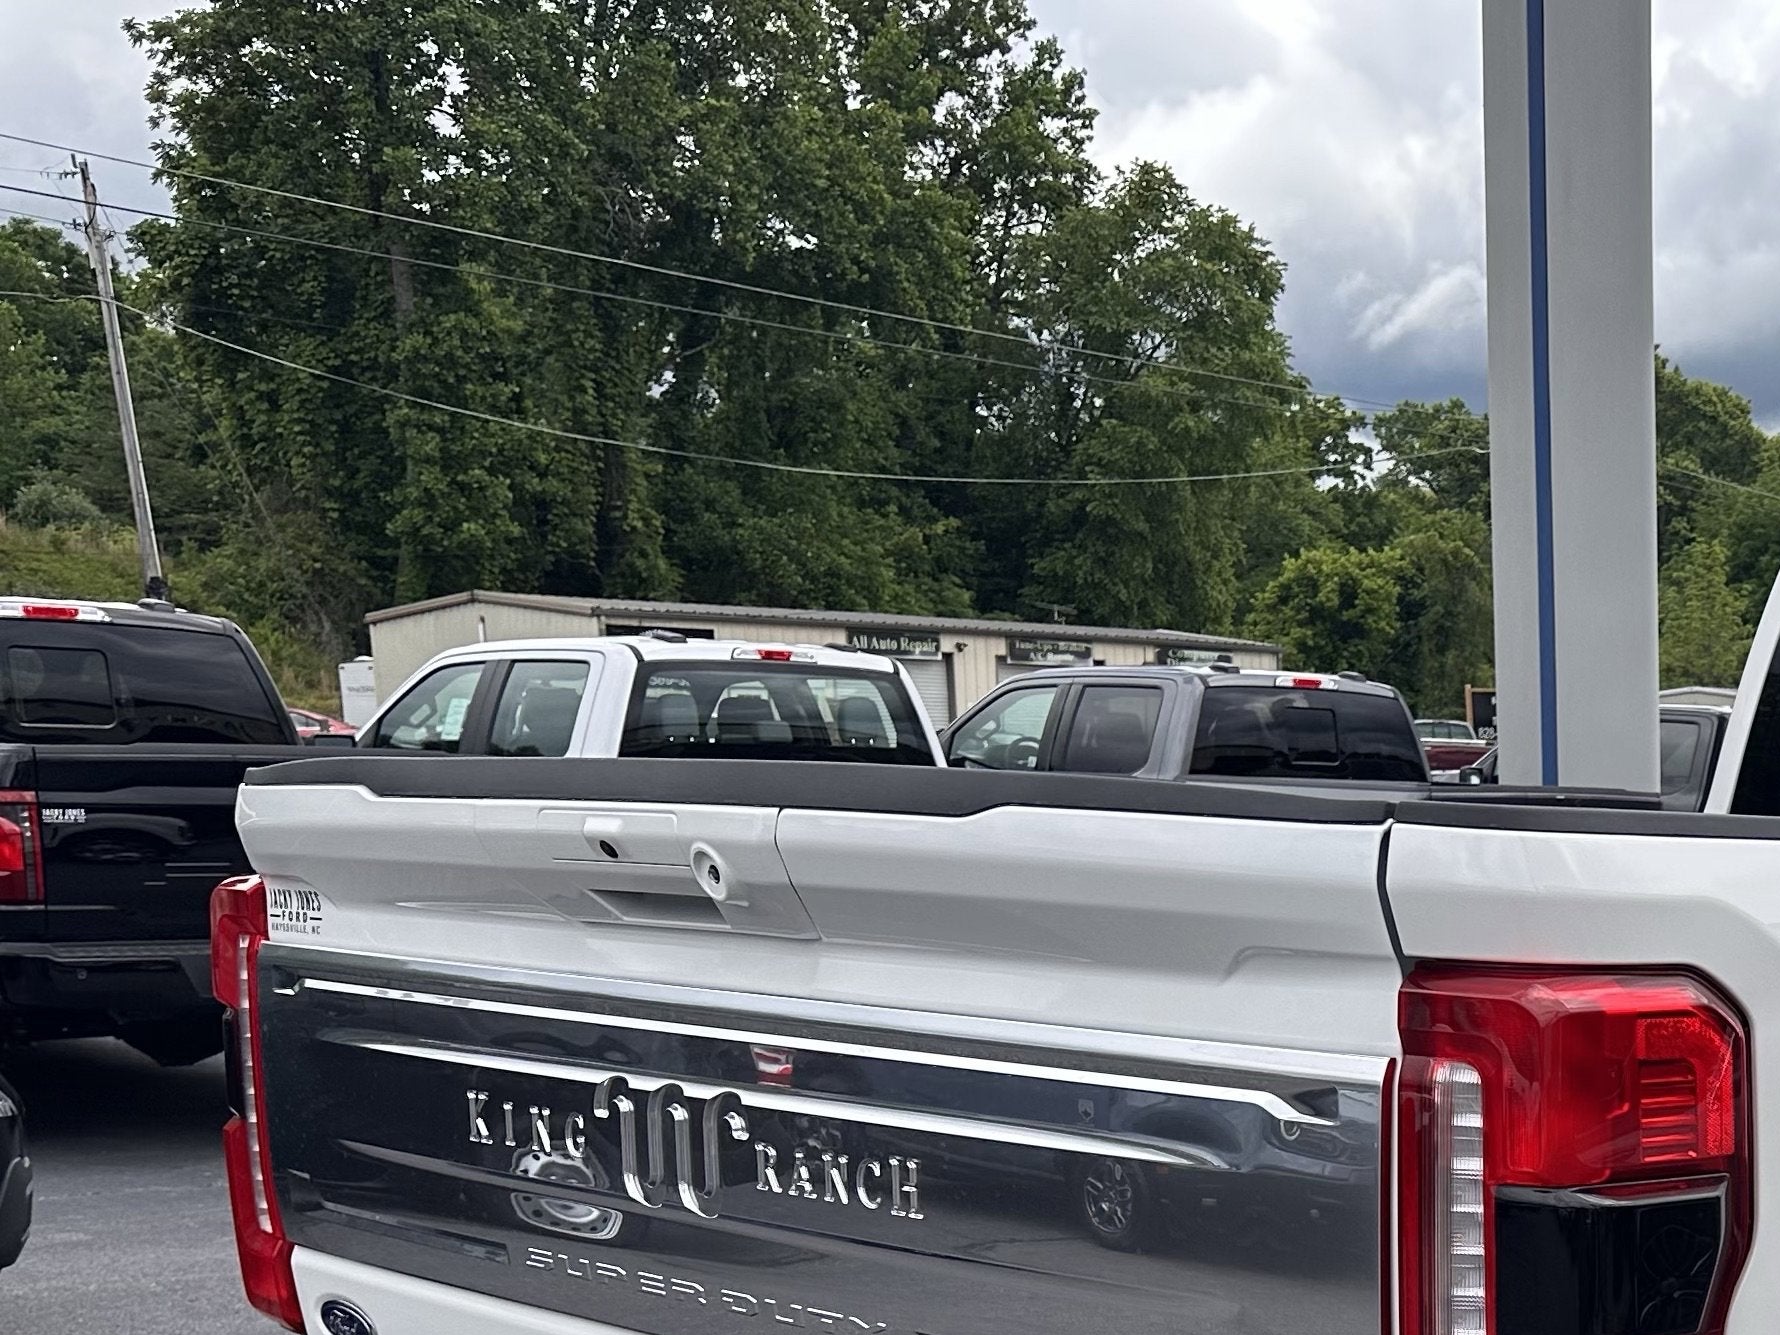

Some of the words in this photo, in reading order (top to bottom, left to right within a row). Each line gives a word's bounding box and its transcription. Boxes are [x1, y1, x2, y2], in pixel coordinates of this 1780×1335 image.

[851, 635, 868, 649] All
[869, 636, 898, 650] Auto
[900, 637, 938, 654] Repair
[269, 888, 293, 910] JACKY
[294, 890, 321, 912] JONES
[282, 910, 308, 923] FORD
[465, 1088, 587, 1159] KING
[754, 1141, 925, 1220] RANCH
[525, 1247, 709, 1305] SUPER
